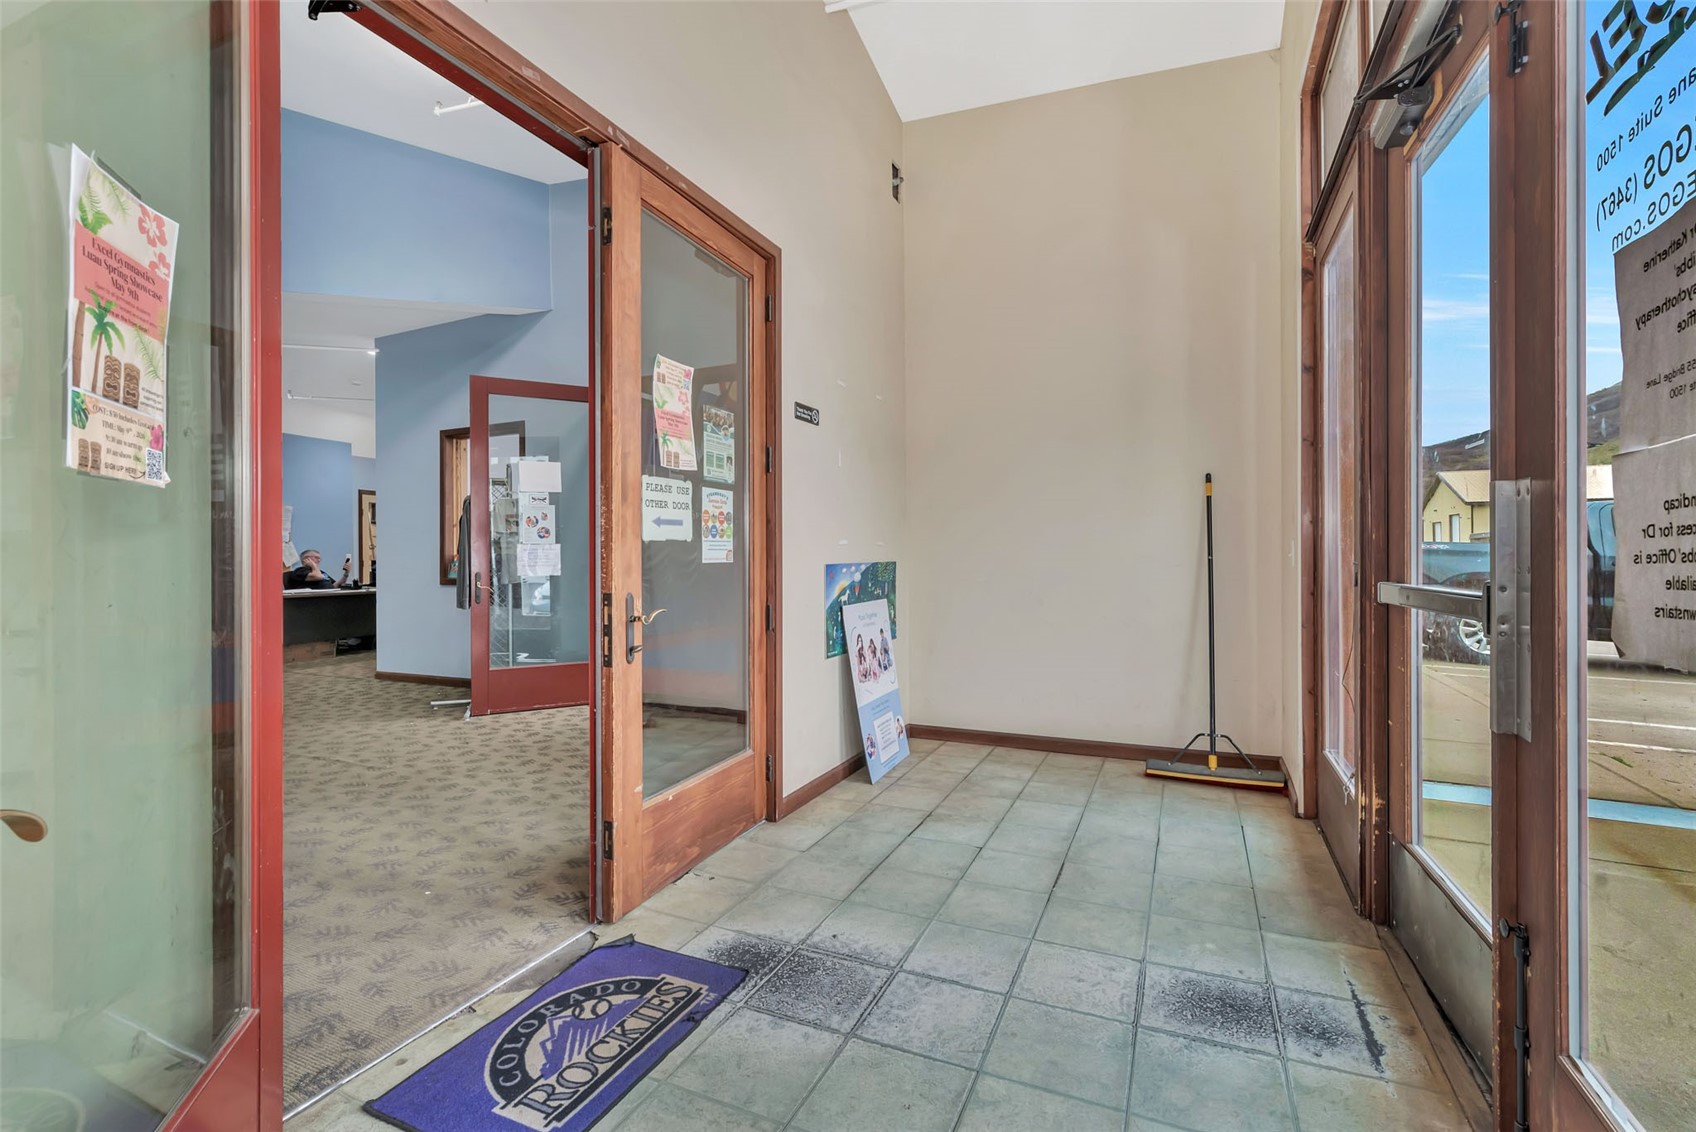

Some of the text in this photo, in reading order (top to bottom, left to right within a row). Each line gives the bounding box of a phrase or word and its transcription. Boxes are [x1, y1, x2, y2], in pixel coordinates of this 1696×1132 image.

[91, 237, 156, 286] Excel Gymnastics
[103, 258, 129, 285] Spring
[129, 274, 163, 303] Showcase
[111, 276, 125, 296] May
[127, 286, 140, 302] 9th
[645, 482, 690, 496] PLEASE USE
[645, 498, 691, 511] OTHER DOOR
[496, 979, 642, 1087] COLORADO
[512, 979, 694, 1121] ROCKIES
